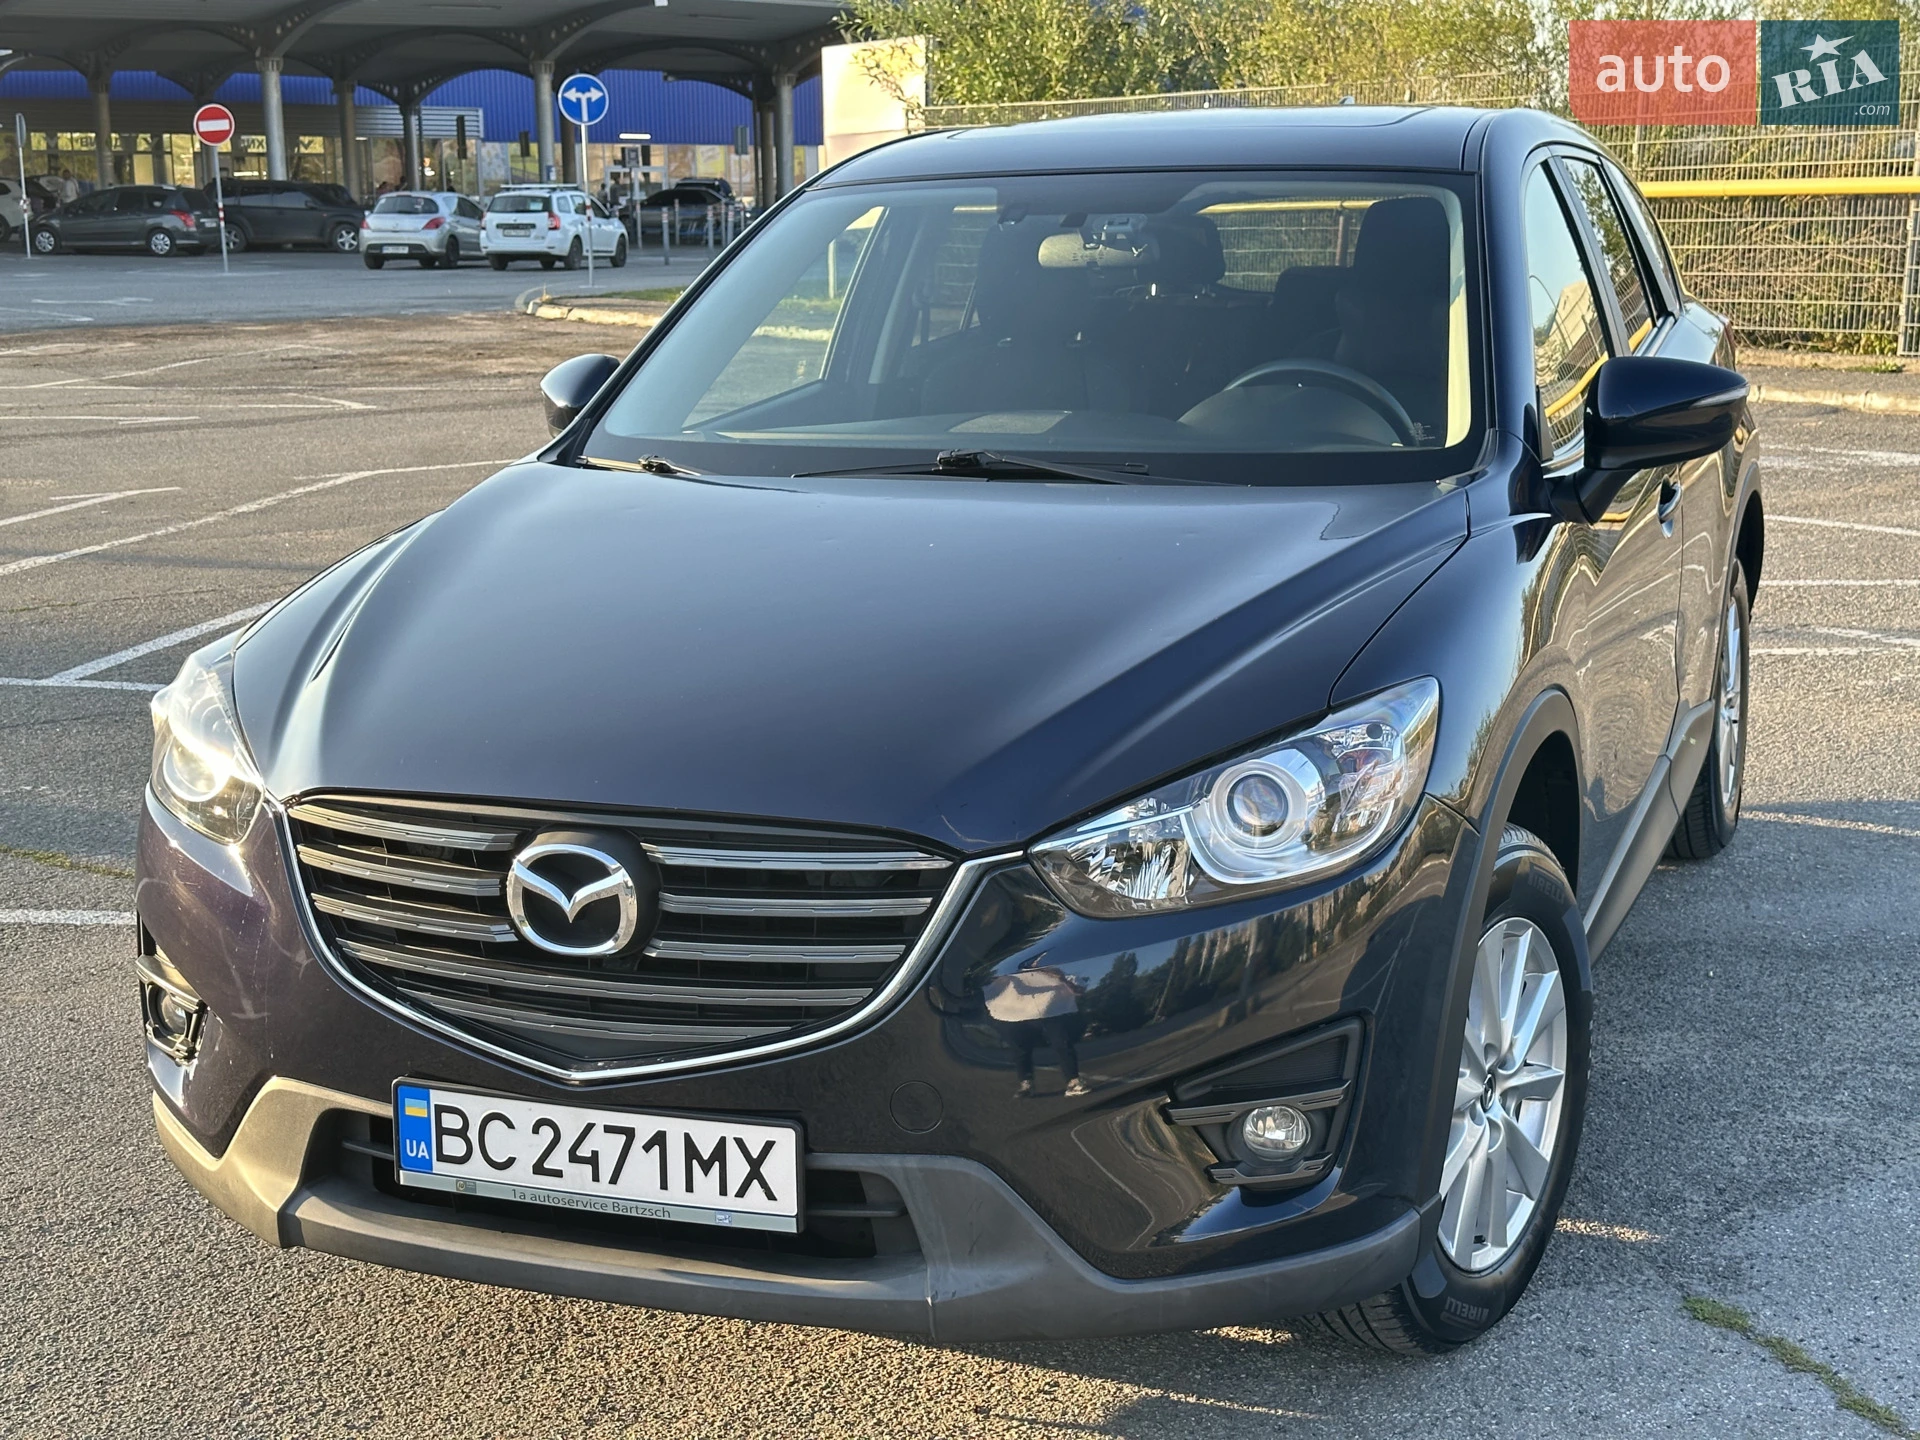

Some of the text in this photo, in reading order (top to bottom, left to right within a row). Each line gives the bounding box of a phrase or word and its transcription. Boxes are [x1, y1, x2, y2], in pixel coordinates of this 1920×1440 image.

[405, 1139, 430, 1160] UA
[531, 1117, 670, 1191] 2471
[530, 1192, 609, 1211] autoservice
[612, 1201, 671, 1219] Bartzsch
